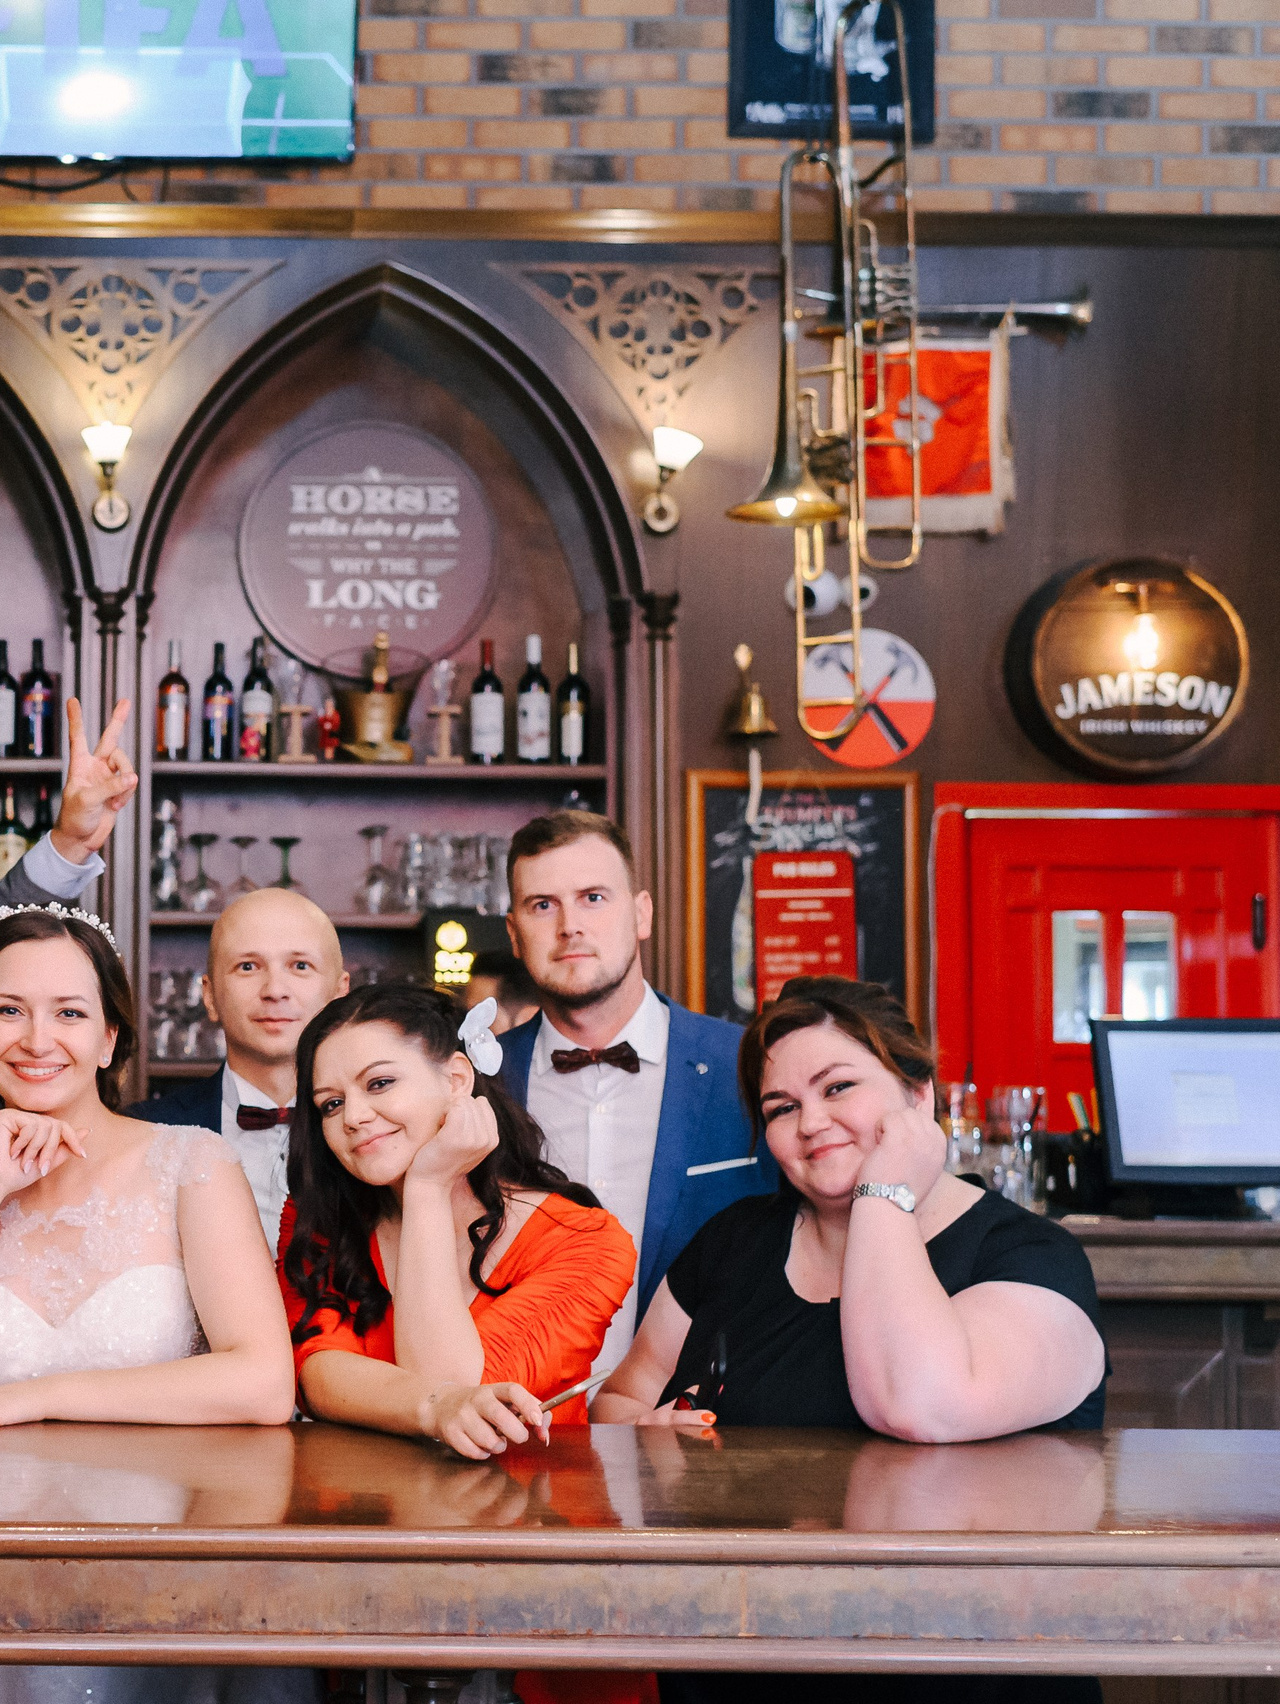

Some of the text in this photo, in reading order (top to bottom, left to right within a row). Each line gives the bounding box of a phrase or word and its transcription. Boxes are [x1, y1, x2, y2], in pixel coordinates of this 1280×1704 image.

[289, 484, 460, 515] HORSE
[329, 557, 417, 575] WHY THE
[306, 578, 441, 610] LONG
[1055, 671, 1232, 720] JAMESON
[1080, 718, 1128, 735] IRISH
